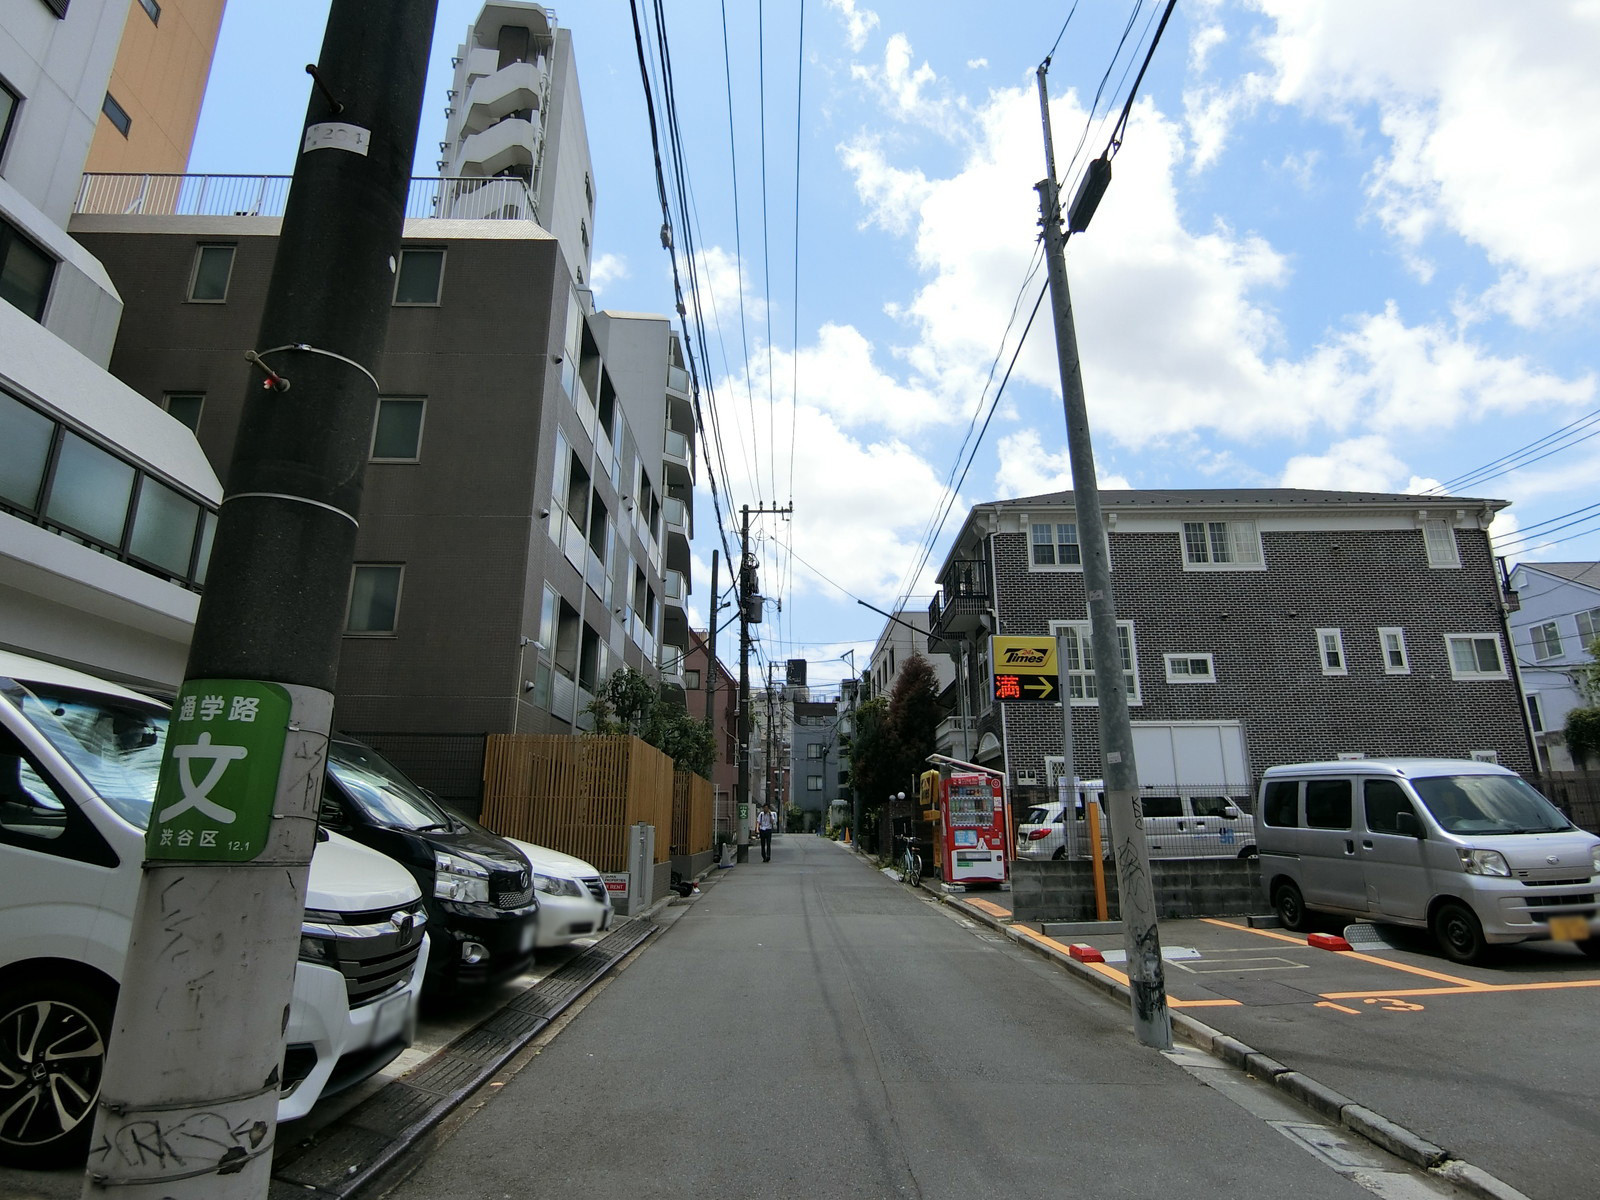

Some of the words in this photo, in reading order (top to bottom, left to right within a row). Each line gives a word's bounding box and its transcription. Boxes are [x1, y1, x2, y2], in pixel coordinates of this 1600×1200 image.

[1003, 648, 1049, 663] Times
[996, 675, 1020, 698] 満
[178, 694, 260, 722] 通学路
[158, 731, 248, 824] 文
[159, 828, 219, 847] 渋谷区
[227, 841, 250, 851] 12.1
[1313, 997, 1425, 1015] 13
